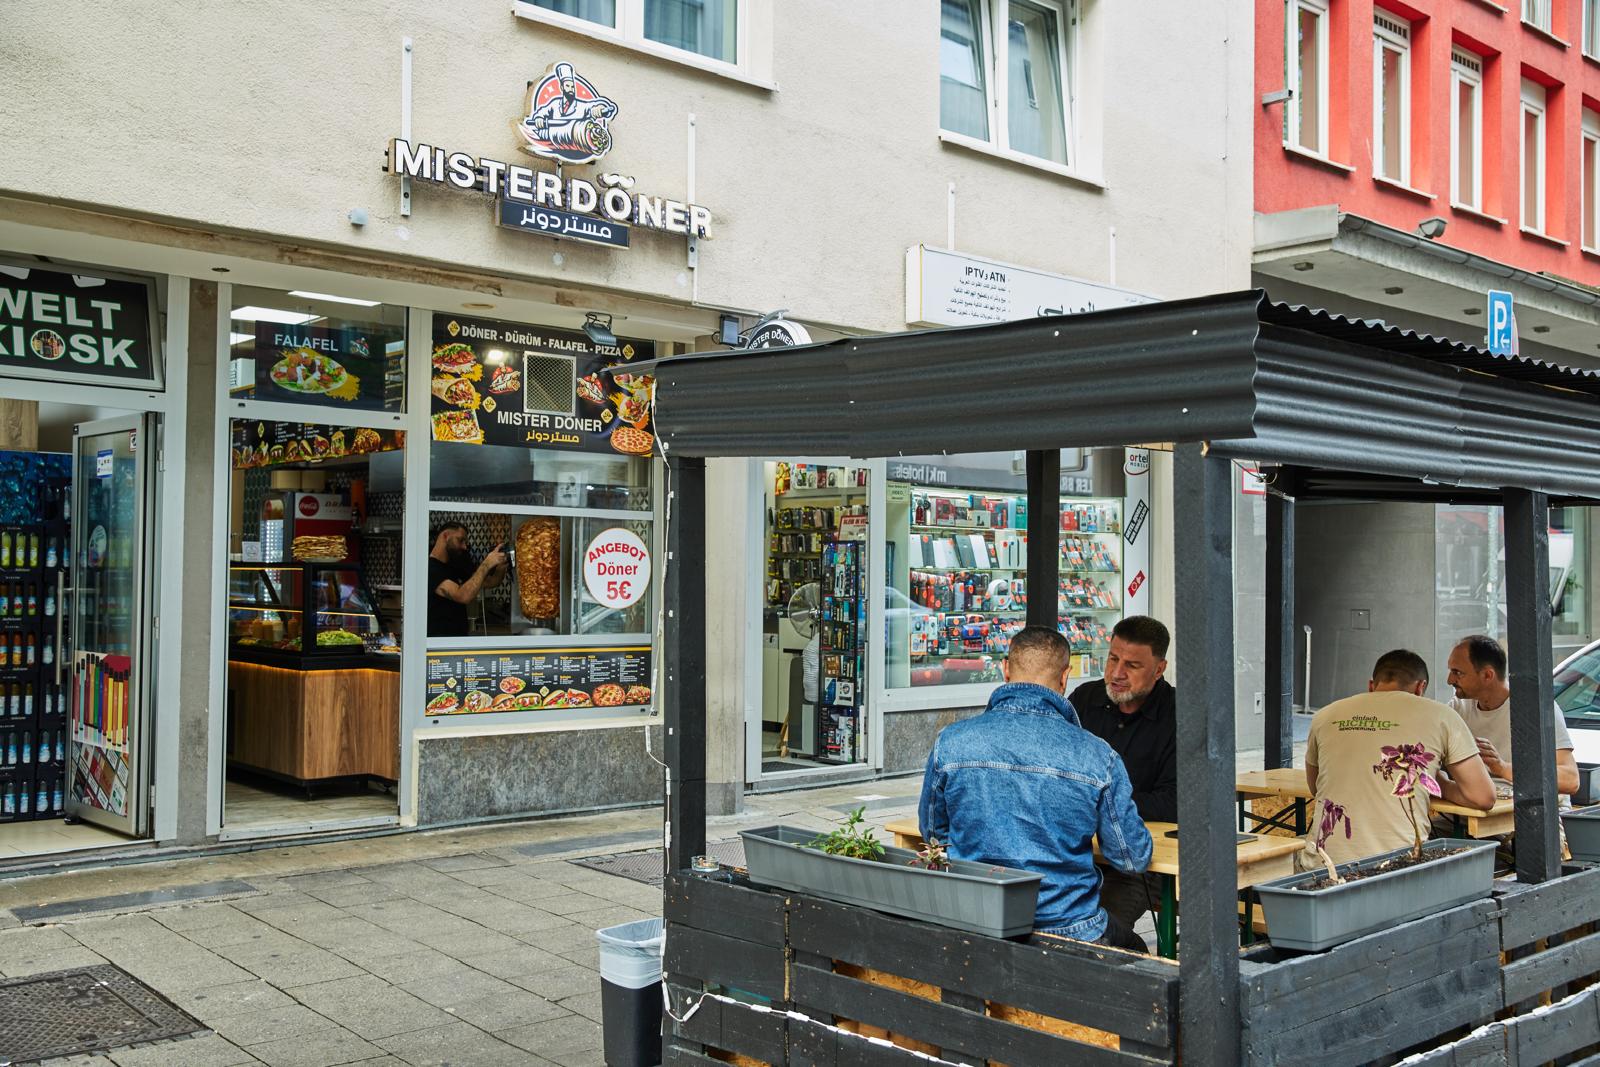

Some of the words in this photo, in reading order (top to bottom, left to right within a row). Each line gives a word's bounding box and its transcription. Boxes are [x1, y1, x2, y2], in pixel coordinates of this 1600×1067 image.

[965, 266, 985, 279] IPTV
[990, 272, 1006, 283] ATN
[1494, 300, 1507, 348] P
[0, 324, 138, 369] IOSK
[274, 333, 339, 352] FALAFEL
[462, 324, 497, 341] DÖNER
[505, 331, 541, 347] DÜRÜM
[548, 338, 588, 353] FALAFEL
[595, 344, 622, 356] PIZZA
[497, 411, 549, 428] MISTER
[1129, 453, 1149, 463] ortel
[589, 543, 646, 563] ANGEBOT
[597, 562, 638, 575] Döner
[607, 581, 631, 600] 5€
